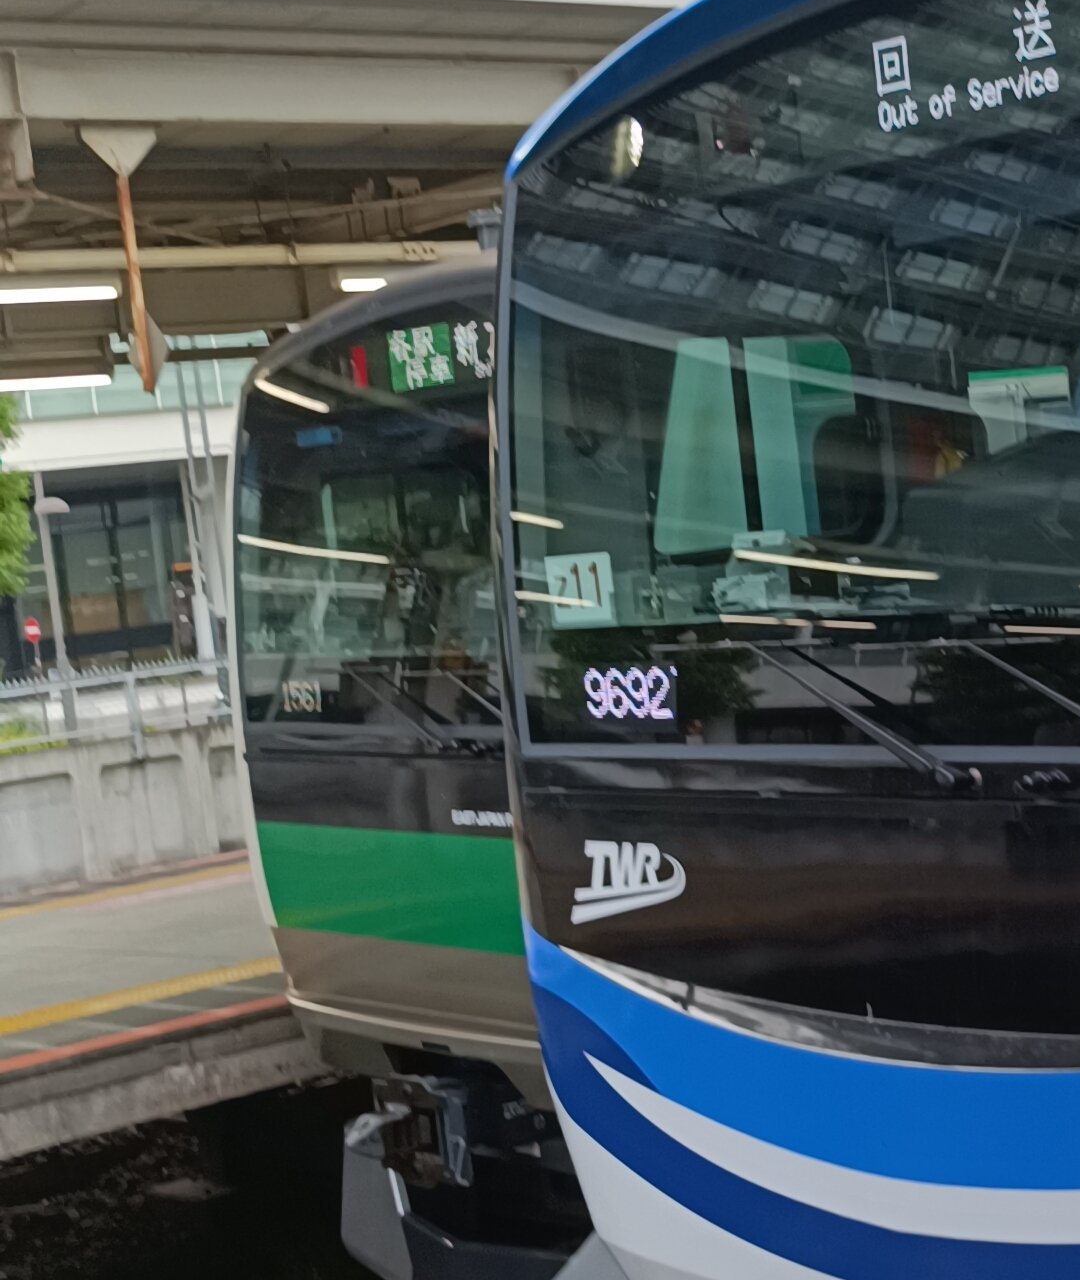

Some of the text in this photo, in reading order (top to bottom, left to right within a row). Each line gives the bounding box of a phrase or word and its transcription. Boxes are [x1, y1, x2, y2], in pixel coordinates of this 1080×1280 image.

[877, 65, 1059, 132] Out of Service
[583, 665, 674, 719] 9692
[584, 839, 661, 888] TWR
